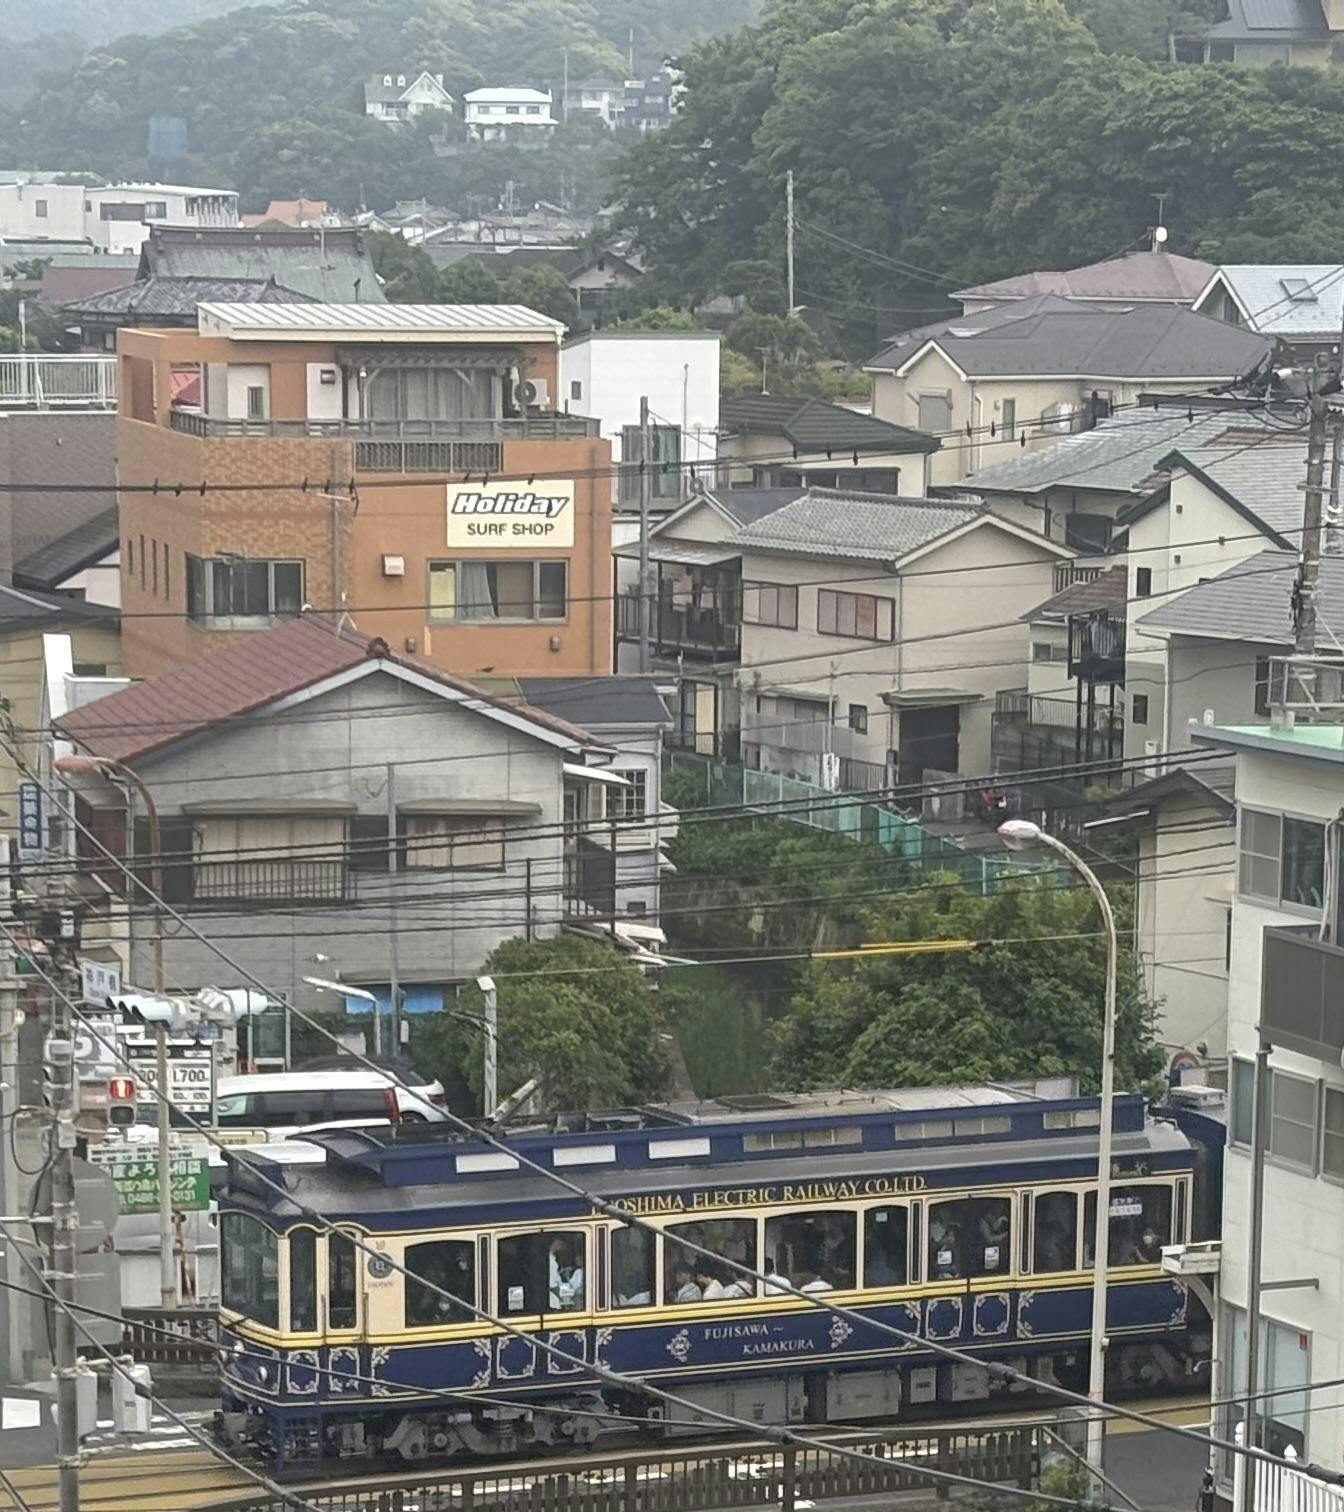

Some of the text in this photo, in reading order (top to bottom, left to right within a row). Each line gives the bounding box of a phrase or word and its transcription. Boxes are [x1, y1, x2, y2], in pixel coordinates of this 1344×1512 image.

[451, 492, 570, 518] Holiday
[467, 522, 555, 536] SURF SHOP
[592, 1193, 686, 1216] OSHIMA
[692, 1186, 777, 1209] ELECTRIC
[783, 1180, 859, 1200] RAILWAY
[704, 1324, 769, 1340] FUJISAWA
[742, 1338, 815, 1355] KAMAKURA
